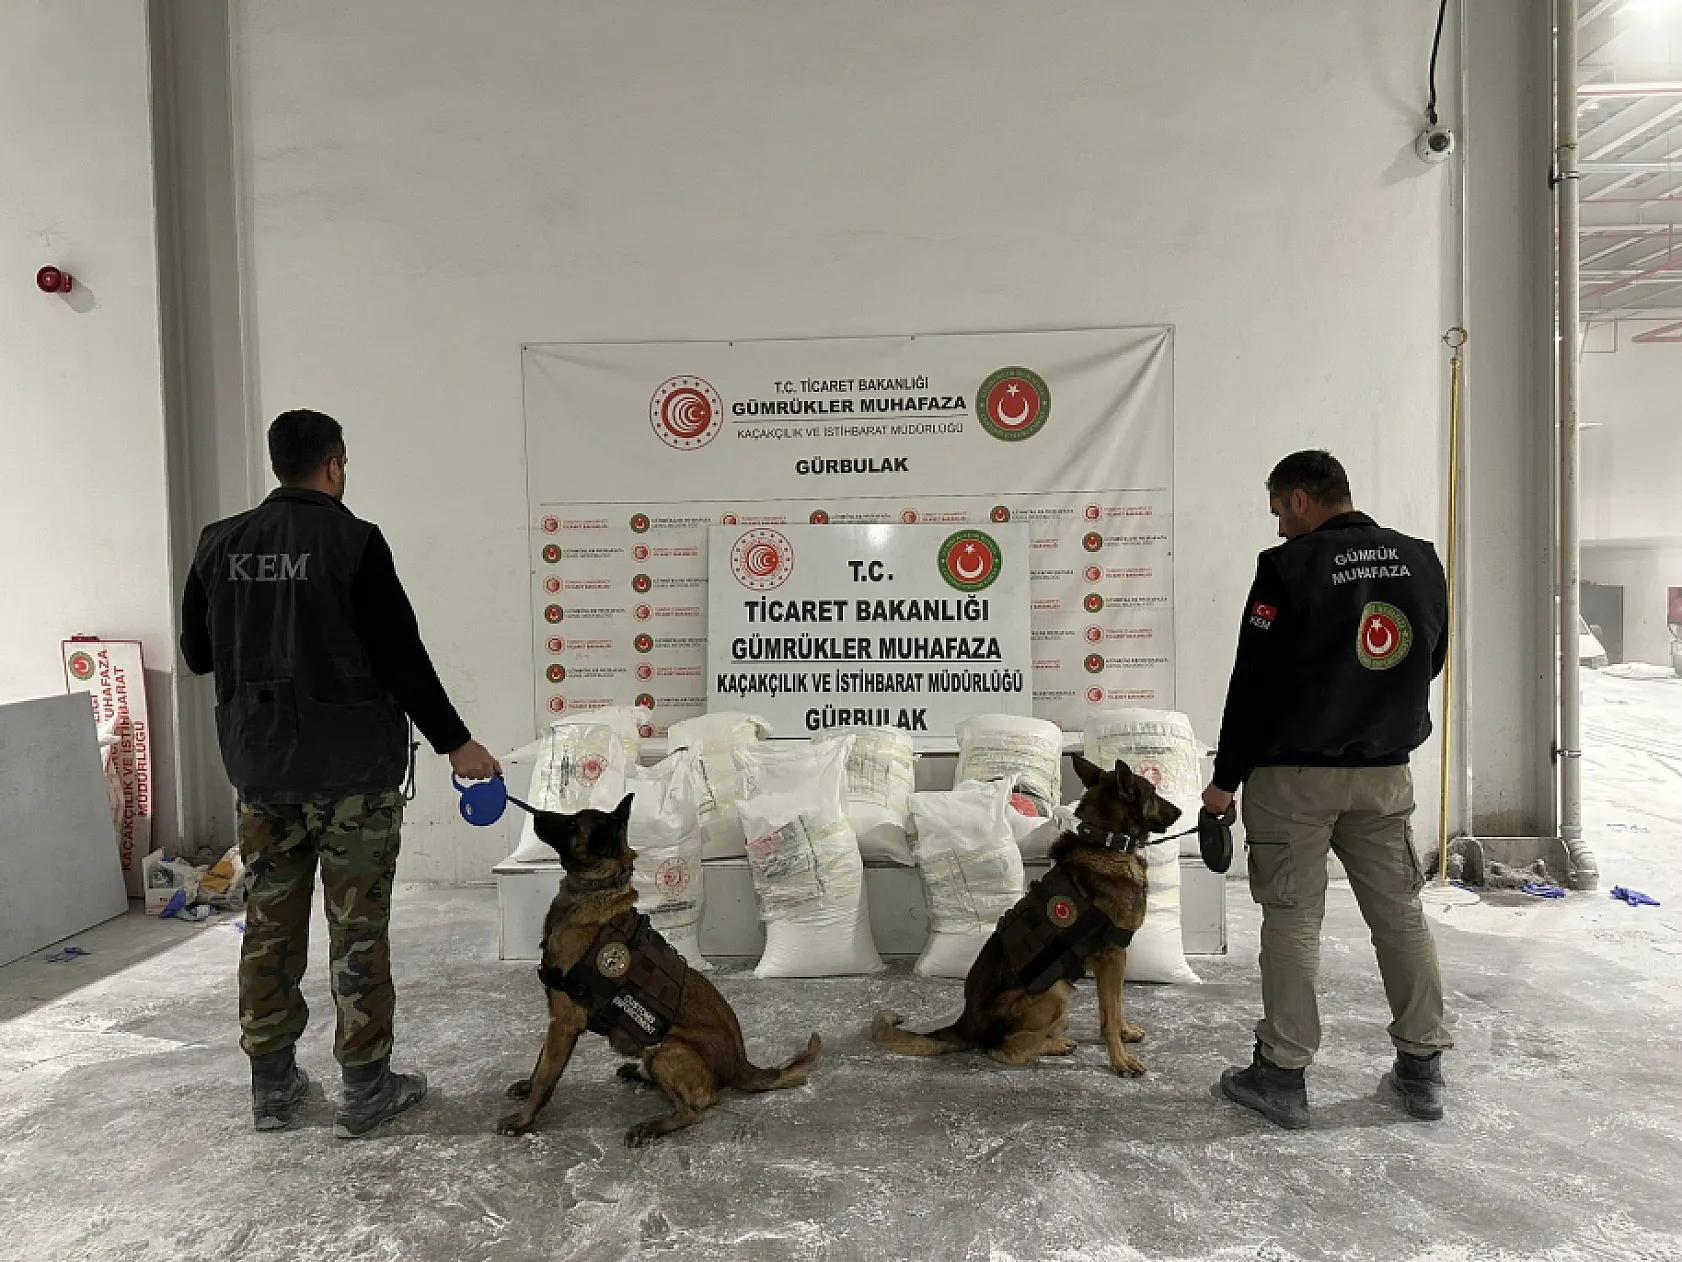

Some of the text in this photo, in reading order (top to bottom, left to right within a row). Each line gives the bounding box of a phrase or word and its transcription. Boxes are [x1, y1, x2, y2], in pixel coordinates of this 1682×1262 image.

[775, 375, 928, 394] T.C. TİCARET BAKANLIĞI
[732, 395, 967, 416] GÜMRÜKLER MUHAFAZA
[738, 427, 802, 441] KAÇAKÇILIK
[805, 427, 821, 438] VE
[890, 422, 963, 436] MÜDÜRLÜĞÜ
[796, 455, 909, 475] GÜRBULAK
[1334, 544, 1399, 565] GÜMRÜK
[227, 553, 311, 581] KEM
[1331, 565, 1411, 586] MUHAFAZA
[745, 594, 989, 623] TİCARET BAKANLIĞI
[731, 633, 872, 660] GÜMRÜKLER
[879, 637, 1002, 660] MUHAFAZA
[97, 648, 115, 722] UHAFAZA
[717, 668, 1023, 697] KAÇAKÇILIK VE İSTİHBARAT MÜDÜRLÜĞÜ
